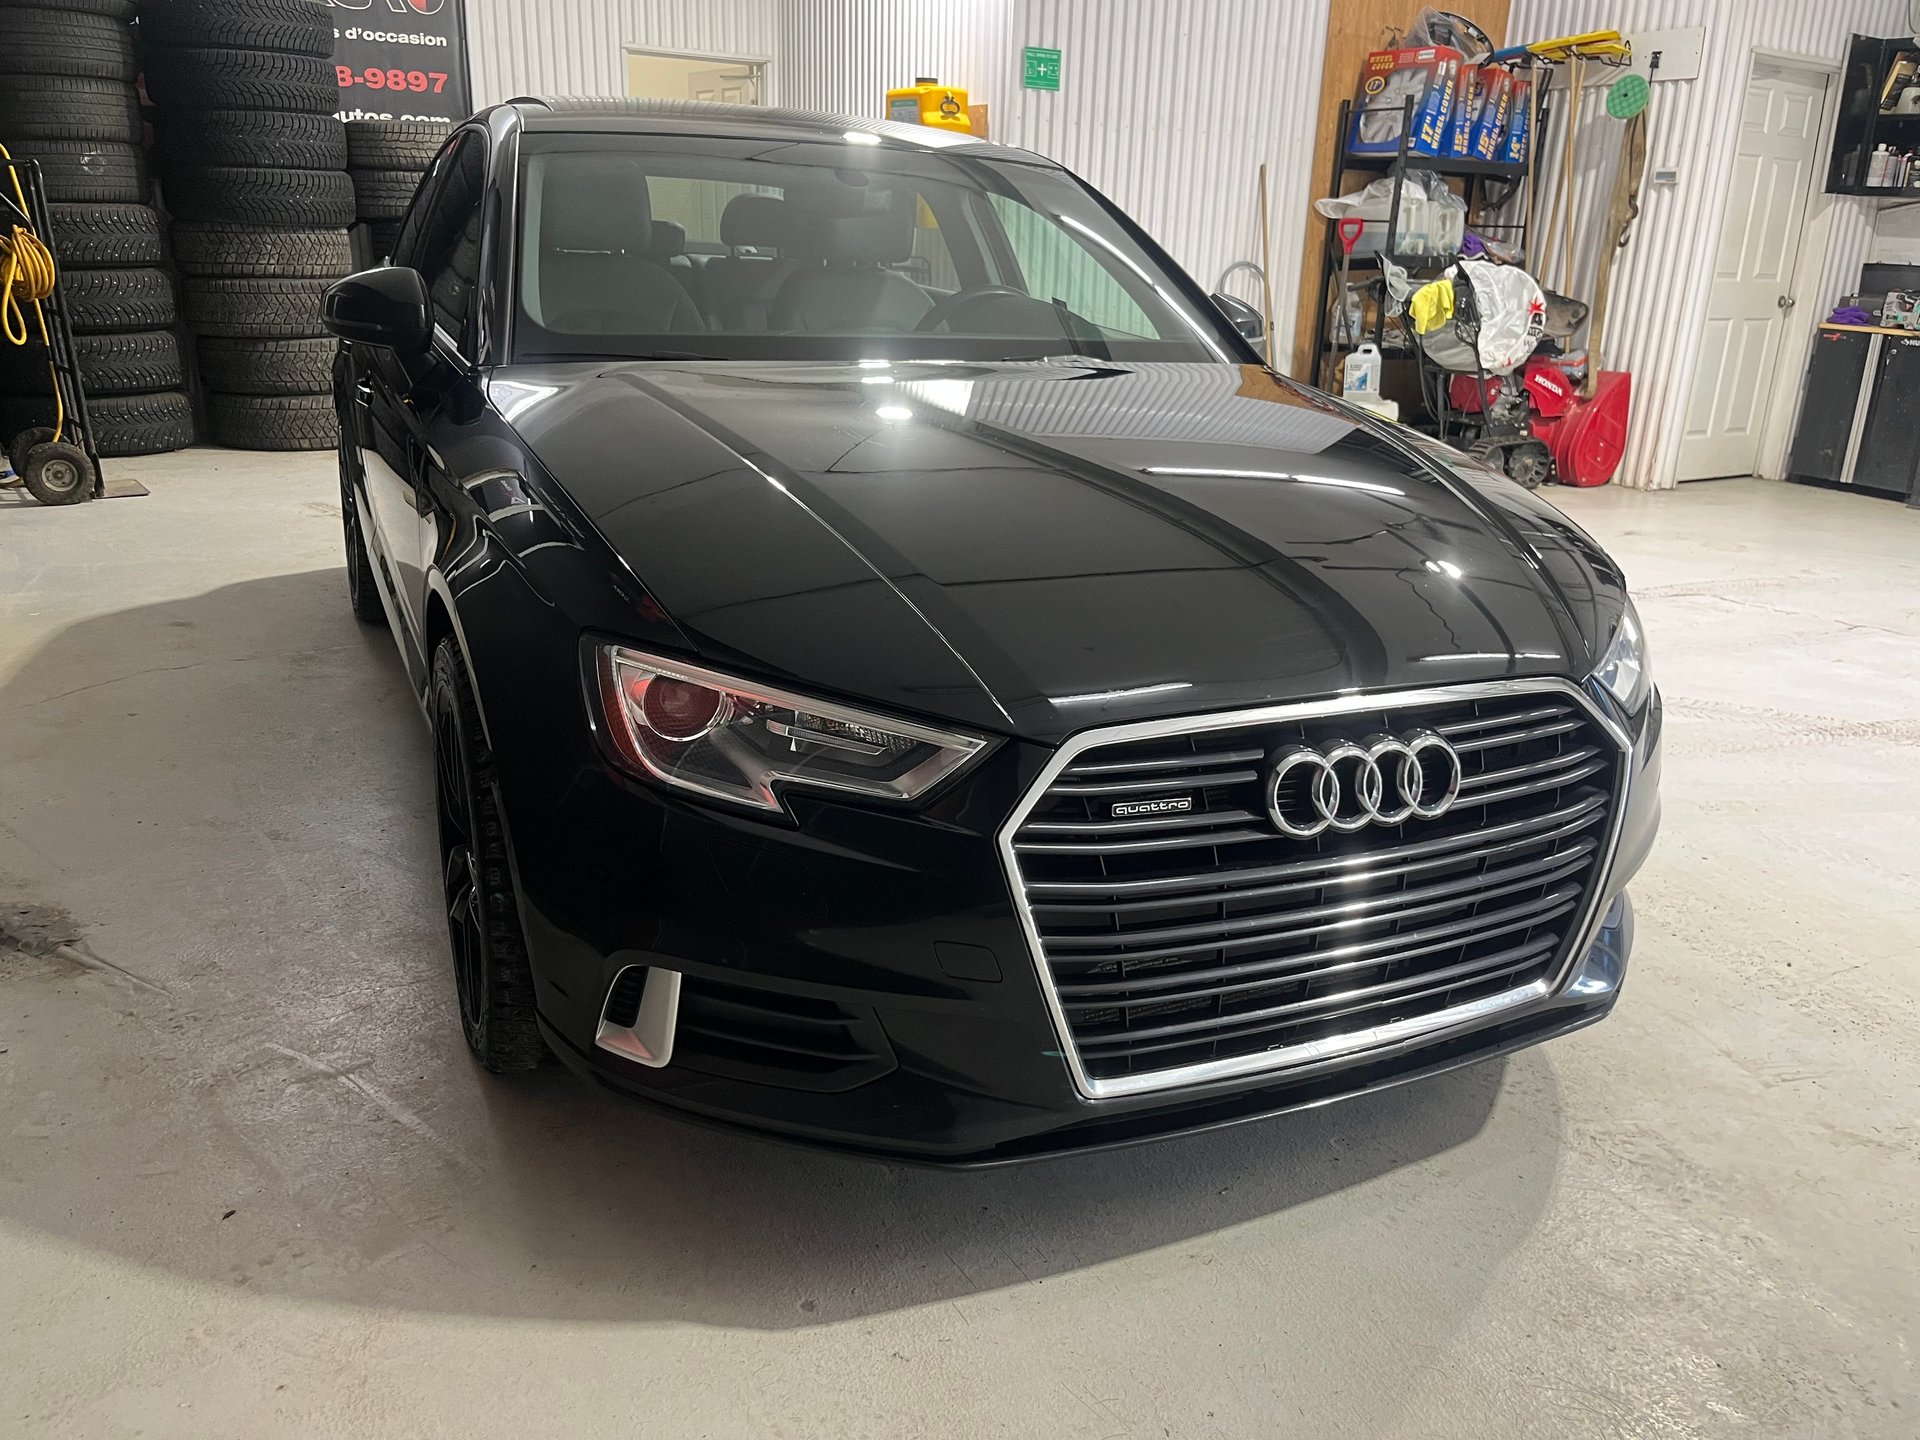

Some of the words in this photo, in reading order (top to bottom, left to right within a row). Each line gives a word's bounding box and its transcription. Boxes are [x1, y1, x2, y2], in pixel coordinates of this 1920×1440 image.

[345, 27, 447, 46] d'occasion
[1431, 115, 1445, 149] WHEEL
[1440, 79, 1454, 114] COVER
[1466, 86, 1475, 119] COVER
[1421, 115, 1434, 144] 17"
[1462, 120, 1471, 155] WHEEL
[1486, 127, 1500, 161] WHEEL
[1496, 93, 1509, 126] COVER
[1534, 374, 1563, 397] HONDA
[1116, 801, 1189, 815] quattro
